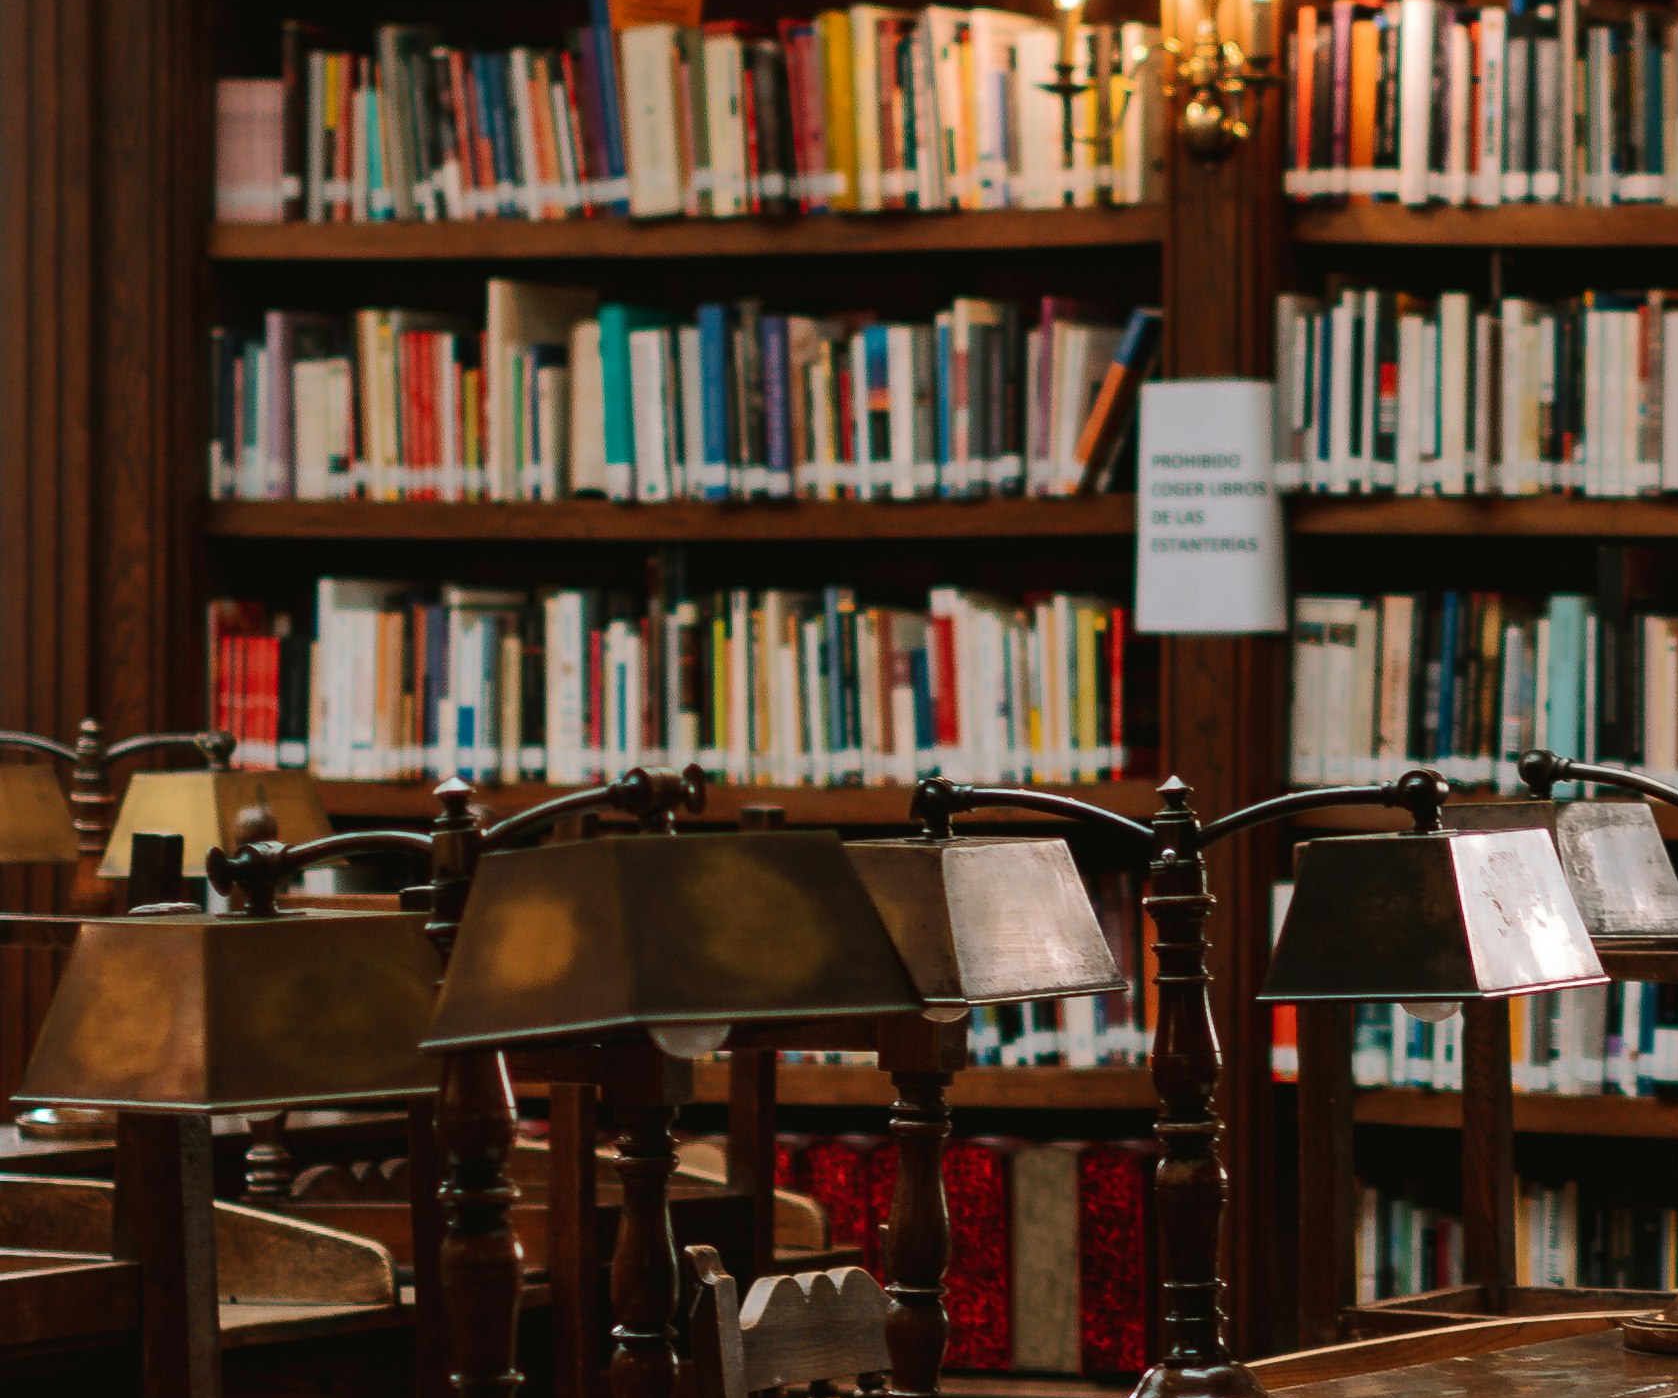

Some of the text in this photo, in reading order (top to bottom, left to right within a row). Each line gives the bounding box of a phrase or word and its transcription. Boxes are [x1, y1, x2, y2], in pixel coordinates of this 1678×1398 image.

[1151, 454, 1241, 469] PROHIBIDO
[1151, 480, 1268, 498] COGER LIBROS
[1151, 509, 1205, 525] DE LAS
